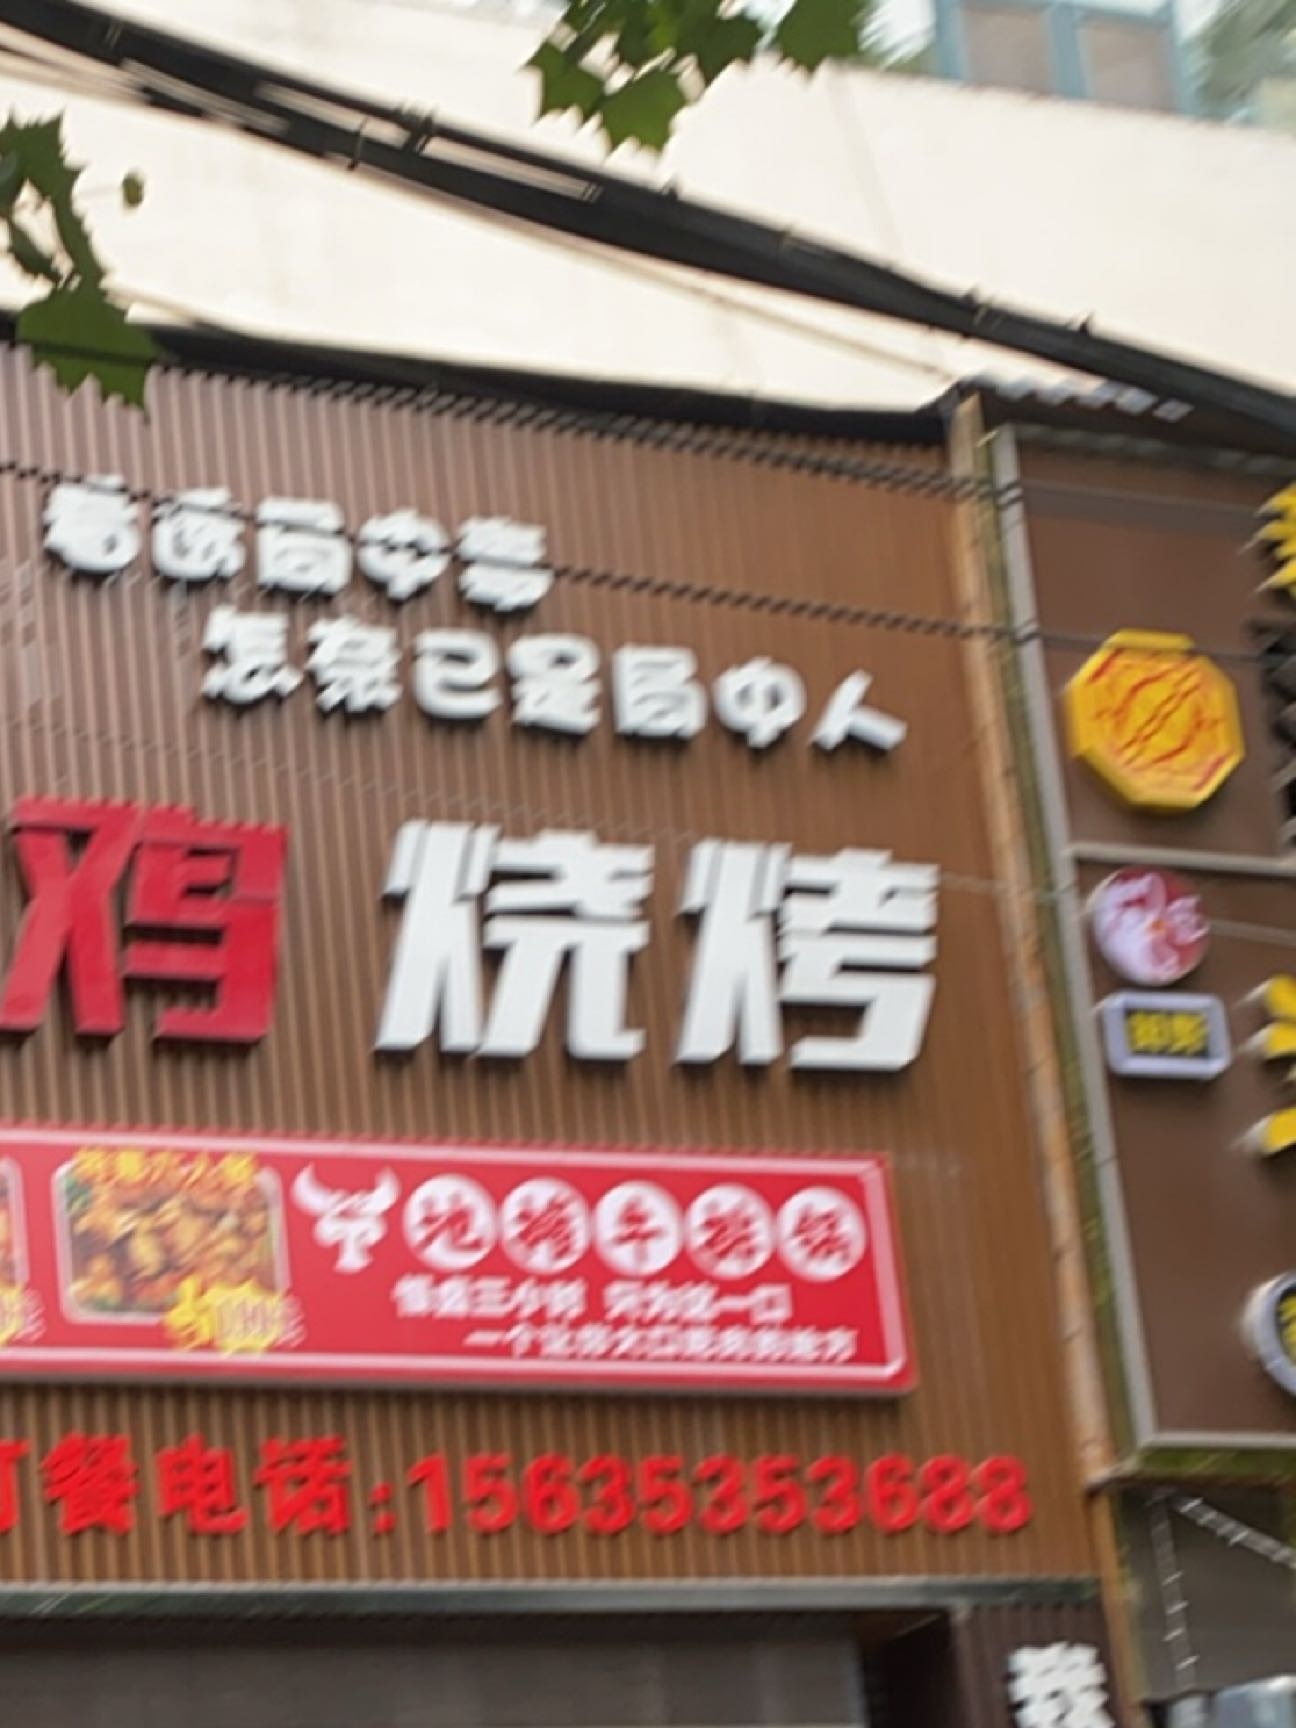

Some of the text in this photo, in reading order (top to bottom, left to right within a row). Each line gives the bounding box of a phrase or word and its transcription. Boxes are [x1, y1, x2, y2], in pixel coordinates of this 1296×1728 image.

[202, 605, 907, 752] 怎奈已是局中人
[374, 818, 941, 1072] 烧烤
